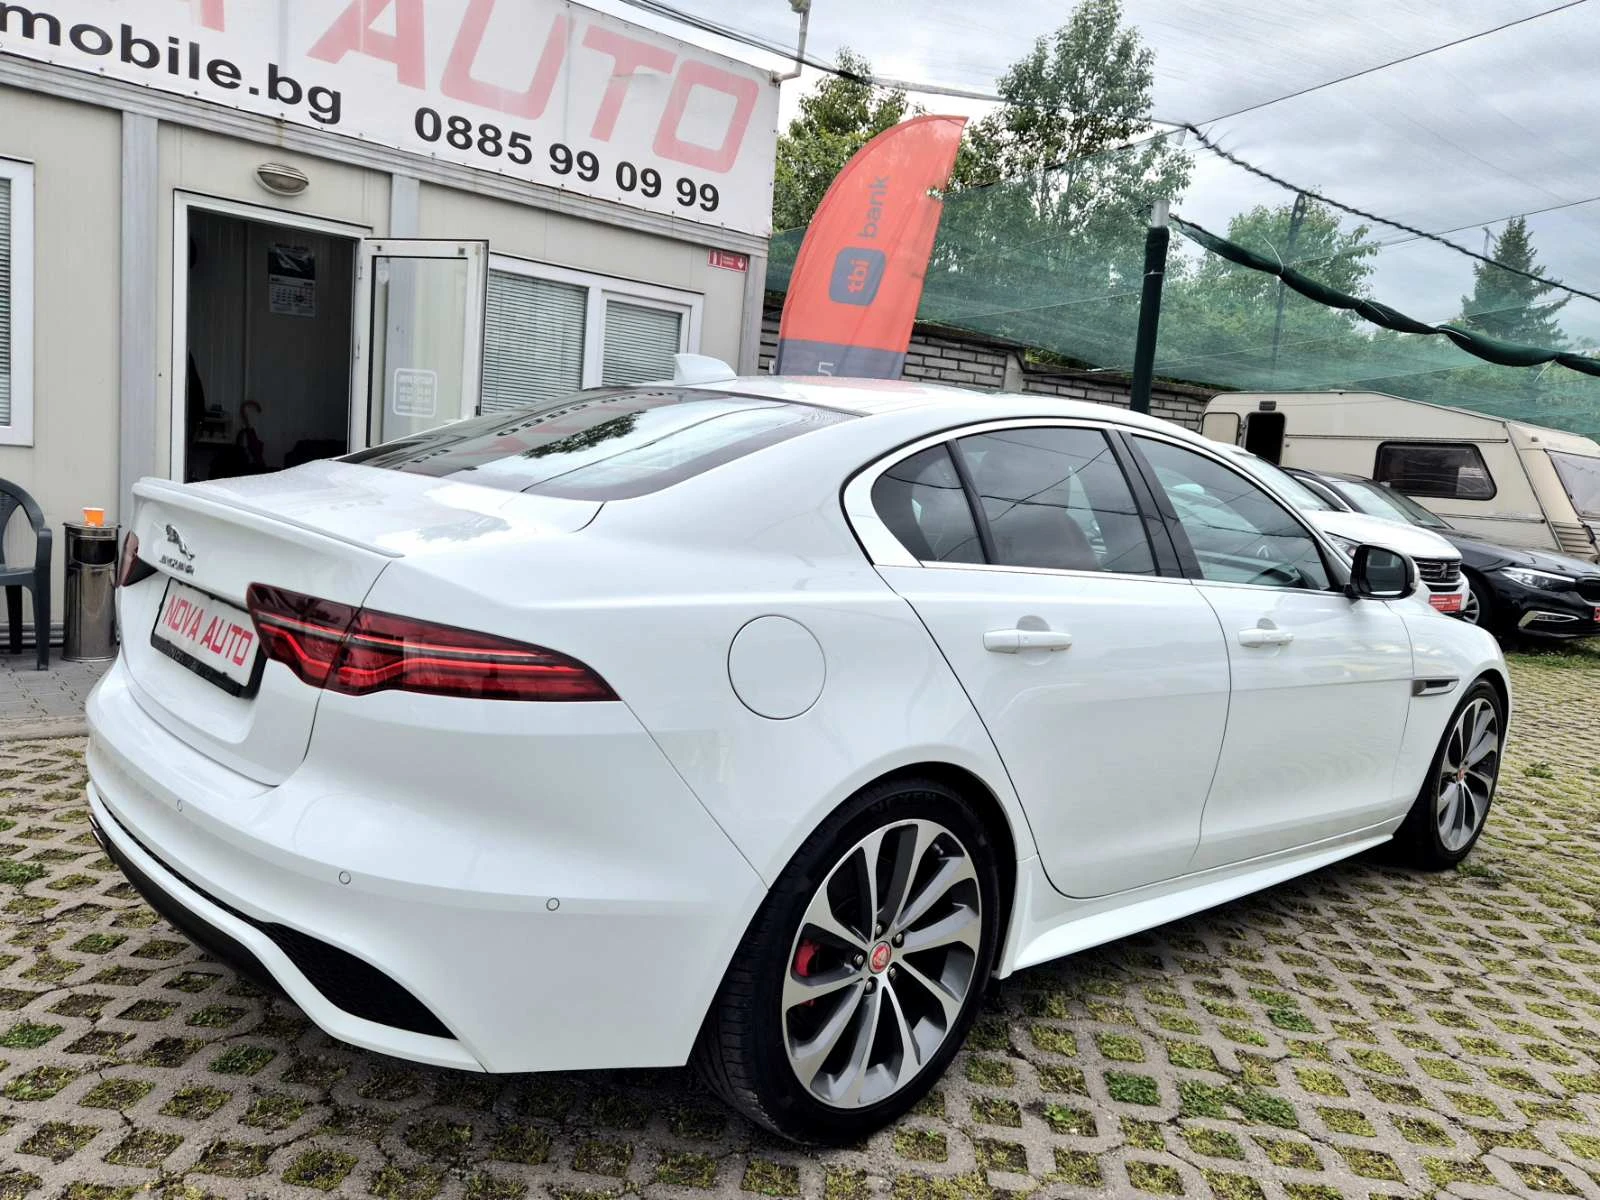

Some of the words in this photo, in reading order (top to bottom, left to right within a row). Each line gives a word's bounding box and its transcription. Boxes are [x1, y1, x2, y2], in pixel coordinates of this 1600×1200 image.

[0, 2, 342, 125] mobile.bg
[306, 0, 759, 174] AUTO
[414, 107, 533, 165] 0885
[549, 143, 600, 182] 99
[615, 161, 662, 198] 09
[676, 177, 720, 212] 99
[857, 175, 892, 240] bank
[847, 259, 872, 294] tbi
[162, 594, 204, 641] NOVA
[201, 615, 254, 667] AUTO
